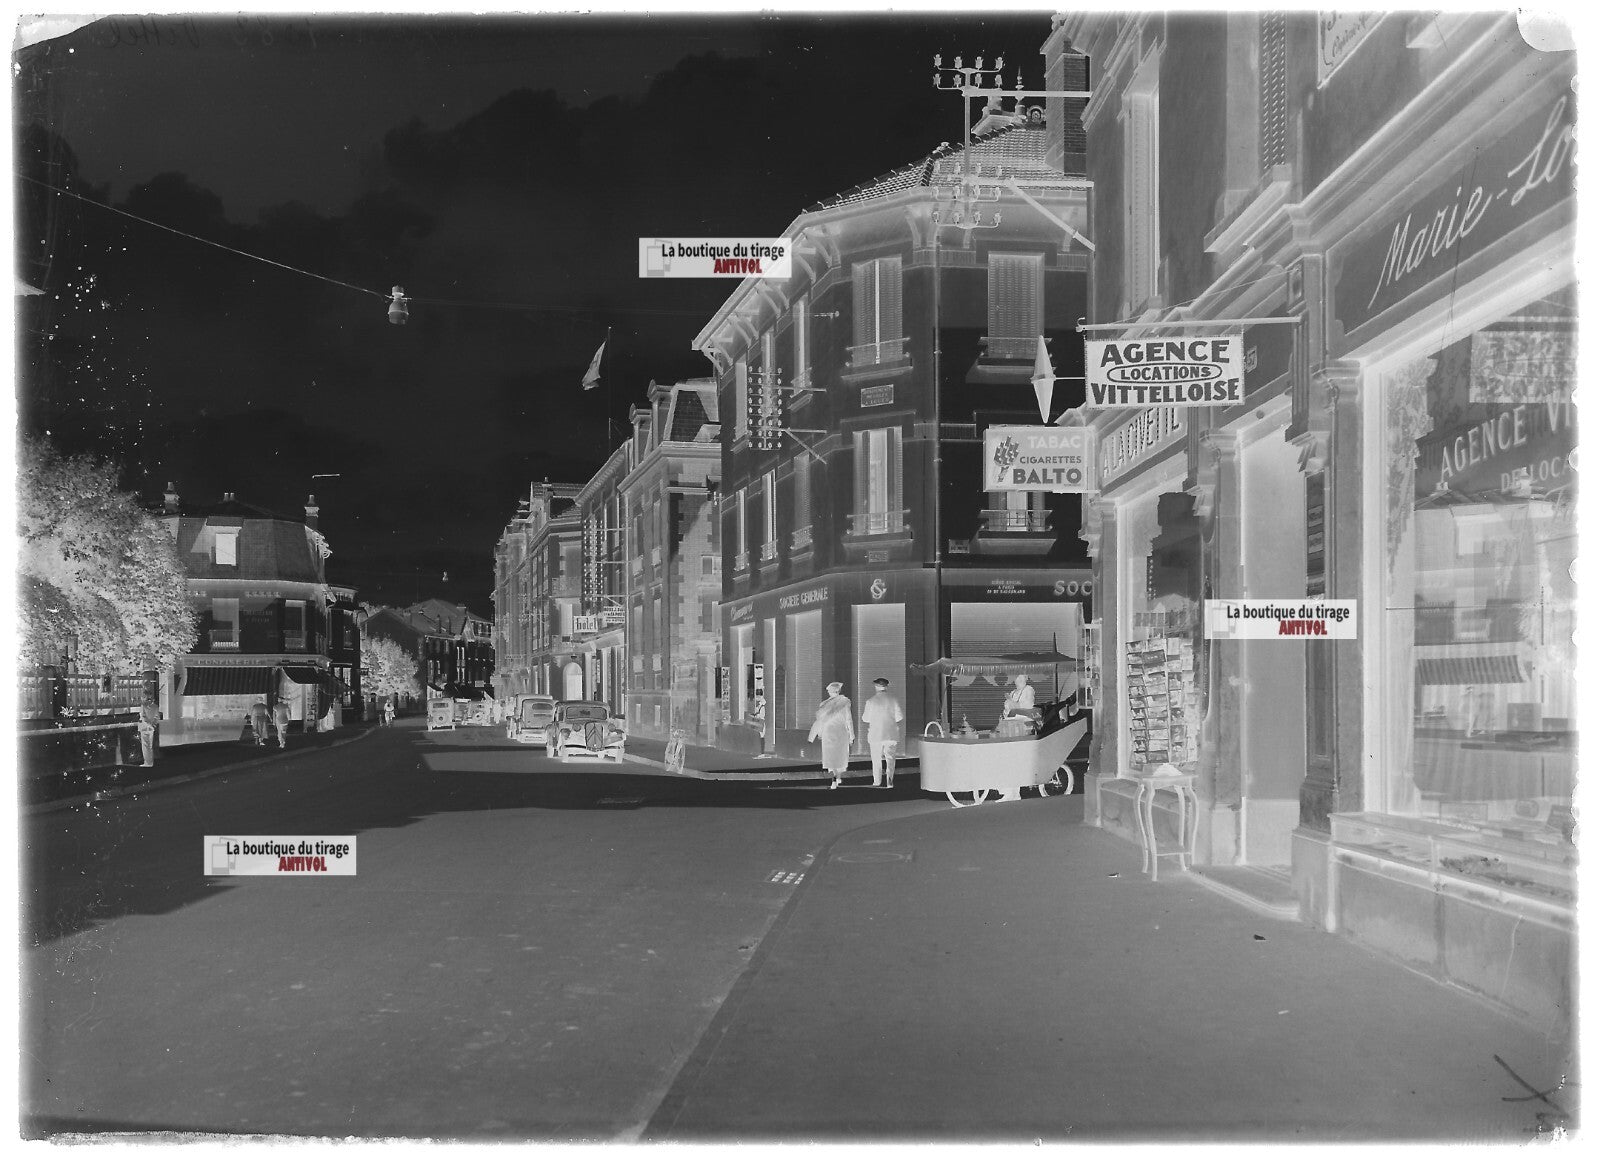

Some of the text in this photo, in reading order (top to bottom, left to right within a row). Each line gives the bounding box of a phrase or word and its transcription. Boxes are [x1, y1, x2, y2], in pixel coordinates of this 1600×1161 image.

[1367, 95, 1577, 309] Marie-Lo
[1100, 340, 1230, 368] AGENCE
[1120, 366, 1212, 381] LOCATIONS
[1090, 377, 1240, 405] VITTELLOISE
[1026, 435, 1081, 449] TABAC
[1440, 404, 1527, 485] AGENCE
[1019, 455, 1082, 465] CIGARETTES
[1012, 467, 1082, 485] BALTO
[1053, 580, 1093, 596] SOC
